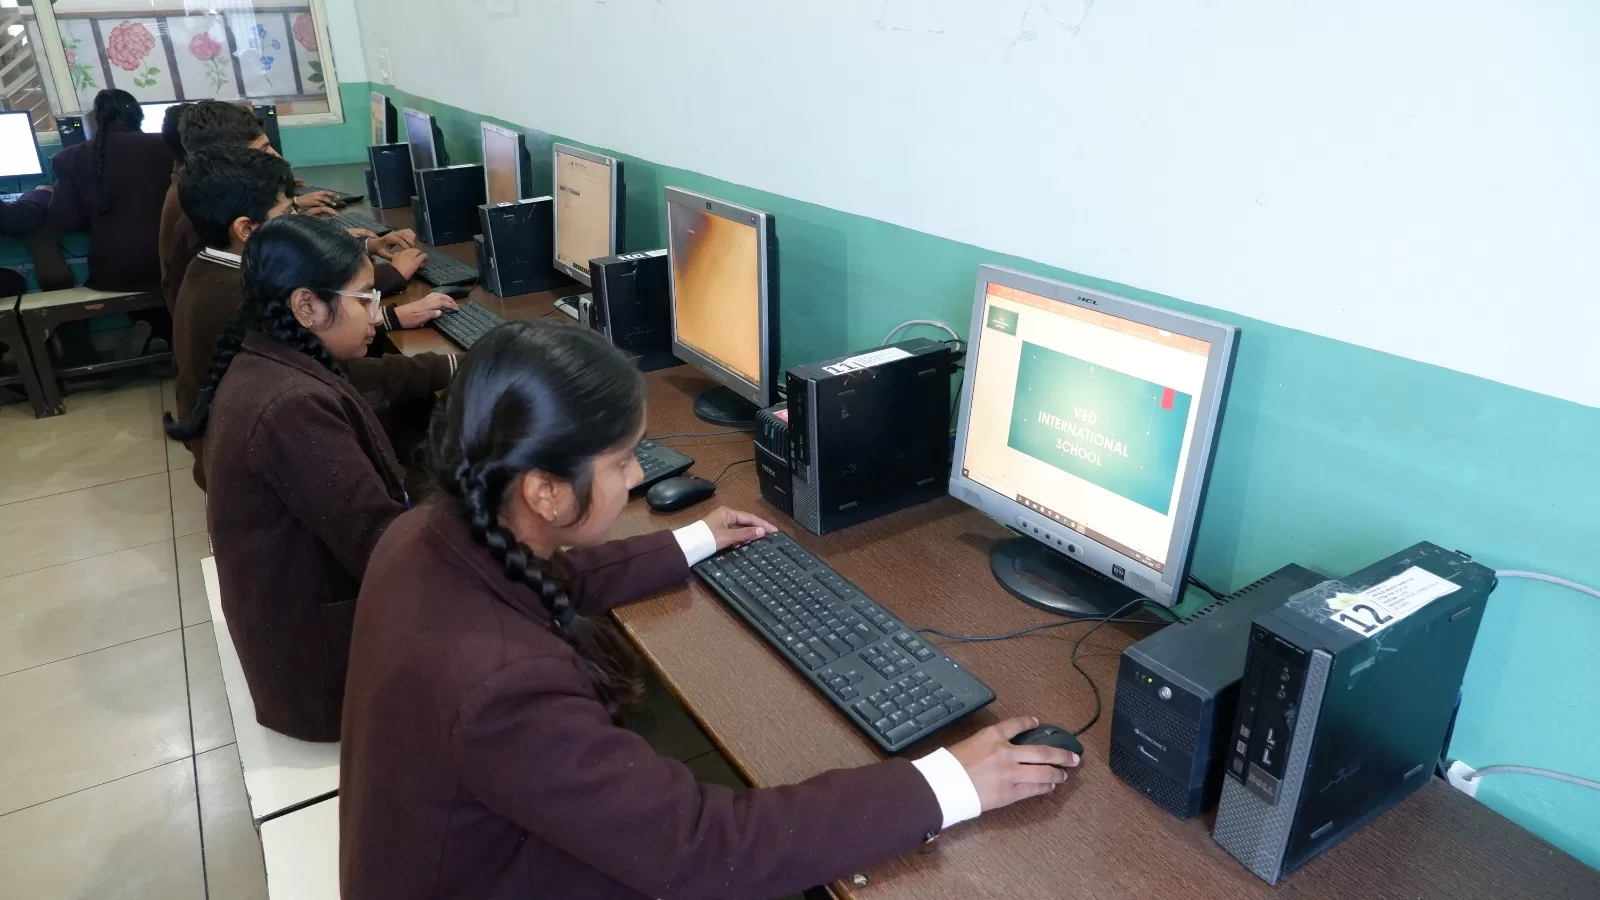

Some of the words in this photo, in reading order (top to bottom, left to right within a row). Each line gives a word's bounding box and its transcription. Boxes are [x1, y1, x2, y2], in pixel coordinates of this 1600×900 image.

[1073, 405, 1097, 425] VED
[1037, 410, 1129, 458] INTERNATIONAL
[1055, 437, 1102, 467] SCHOOL
[1339, 604, 1394, 633] 12
